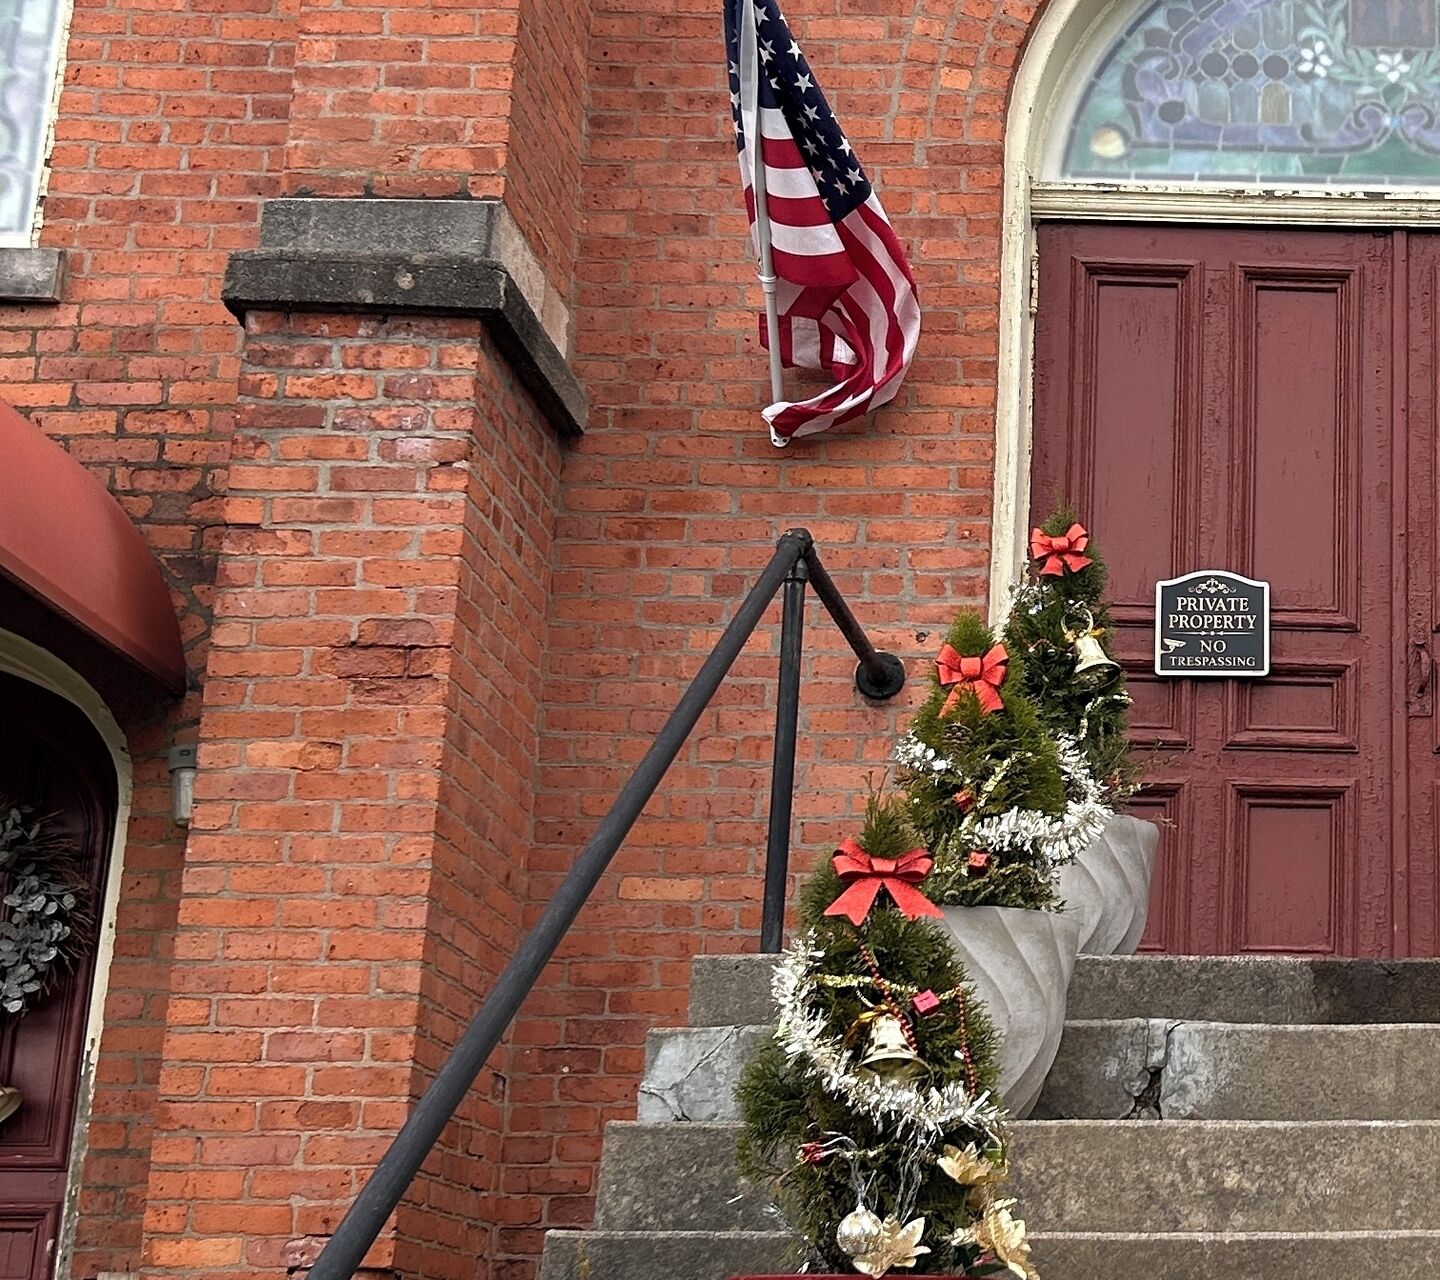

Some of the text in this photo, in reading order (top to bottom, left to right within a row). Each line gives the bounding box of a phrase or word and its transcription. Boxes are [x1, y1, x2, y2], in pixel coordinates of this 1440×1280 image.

[1176, 596, 1250, 612] PRIVATE
[1168, 614, 1257, 629] PROPERTY
[1199, 639, 1227, 653] NO
[1169, 656, 1256, 667] TRESPASSING
